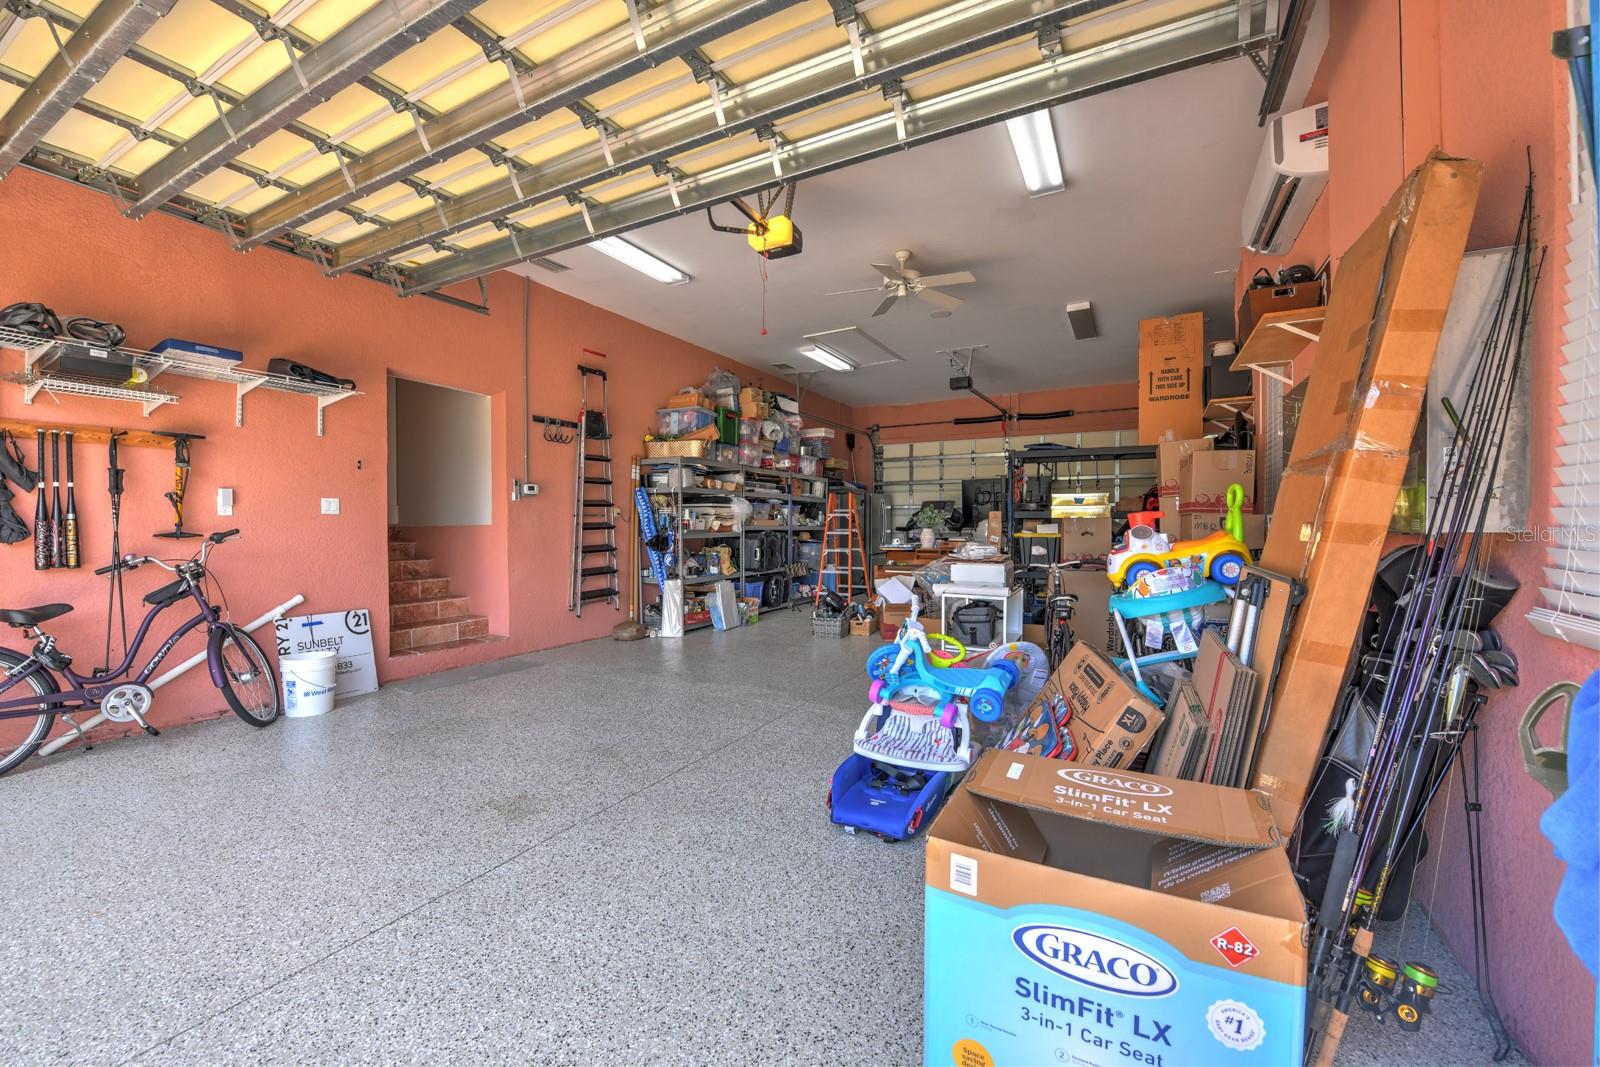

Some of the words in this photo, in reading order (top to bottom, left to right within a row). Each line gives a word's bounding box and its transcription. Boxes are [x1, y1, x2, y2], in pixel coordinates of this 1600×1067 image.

[1148, 393, 1190, 402] WARDROBE
[353, 611, 369, 629] 21
[1106, 611, 1115, 653] Wardrobe
[297, 636, 345, 652] SUNBELT
[311, 688, 328, 698] West
[1122, 713, 1137, 727] XL
[1095, 739, 1114, 760] Place
[1072, 770, 1161, 793] GRACO
[1055, 796, 1098, 811] 3-in-1
[1102, 805, 1129, 817] Car
[1132, 811, 1168, 824] Seat
[1143, 801, 1174, 816] LX
[1217, 937, 1253, 956] R-82
[1035, 932, 1159, 987] GRACO
[1133, 1014, 1173, 1048] LX
[1225, 1015, 1243, 1036] #1
[1020, 1006, 1072, 1037] 3-in-1
[1080, 1027, 1114, 1051] Car
[1119, 1041, 1164, 1067] Seat
[962, 1046, 985, 1060] Space
